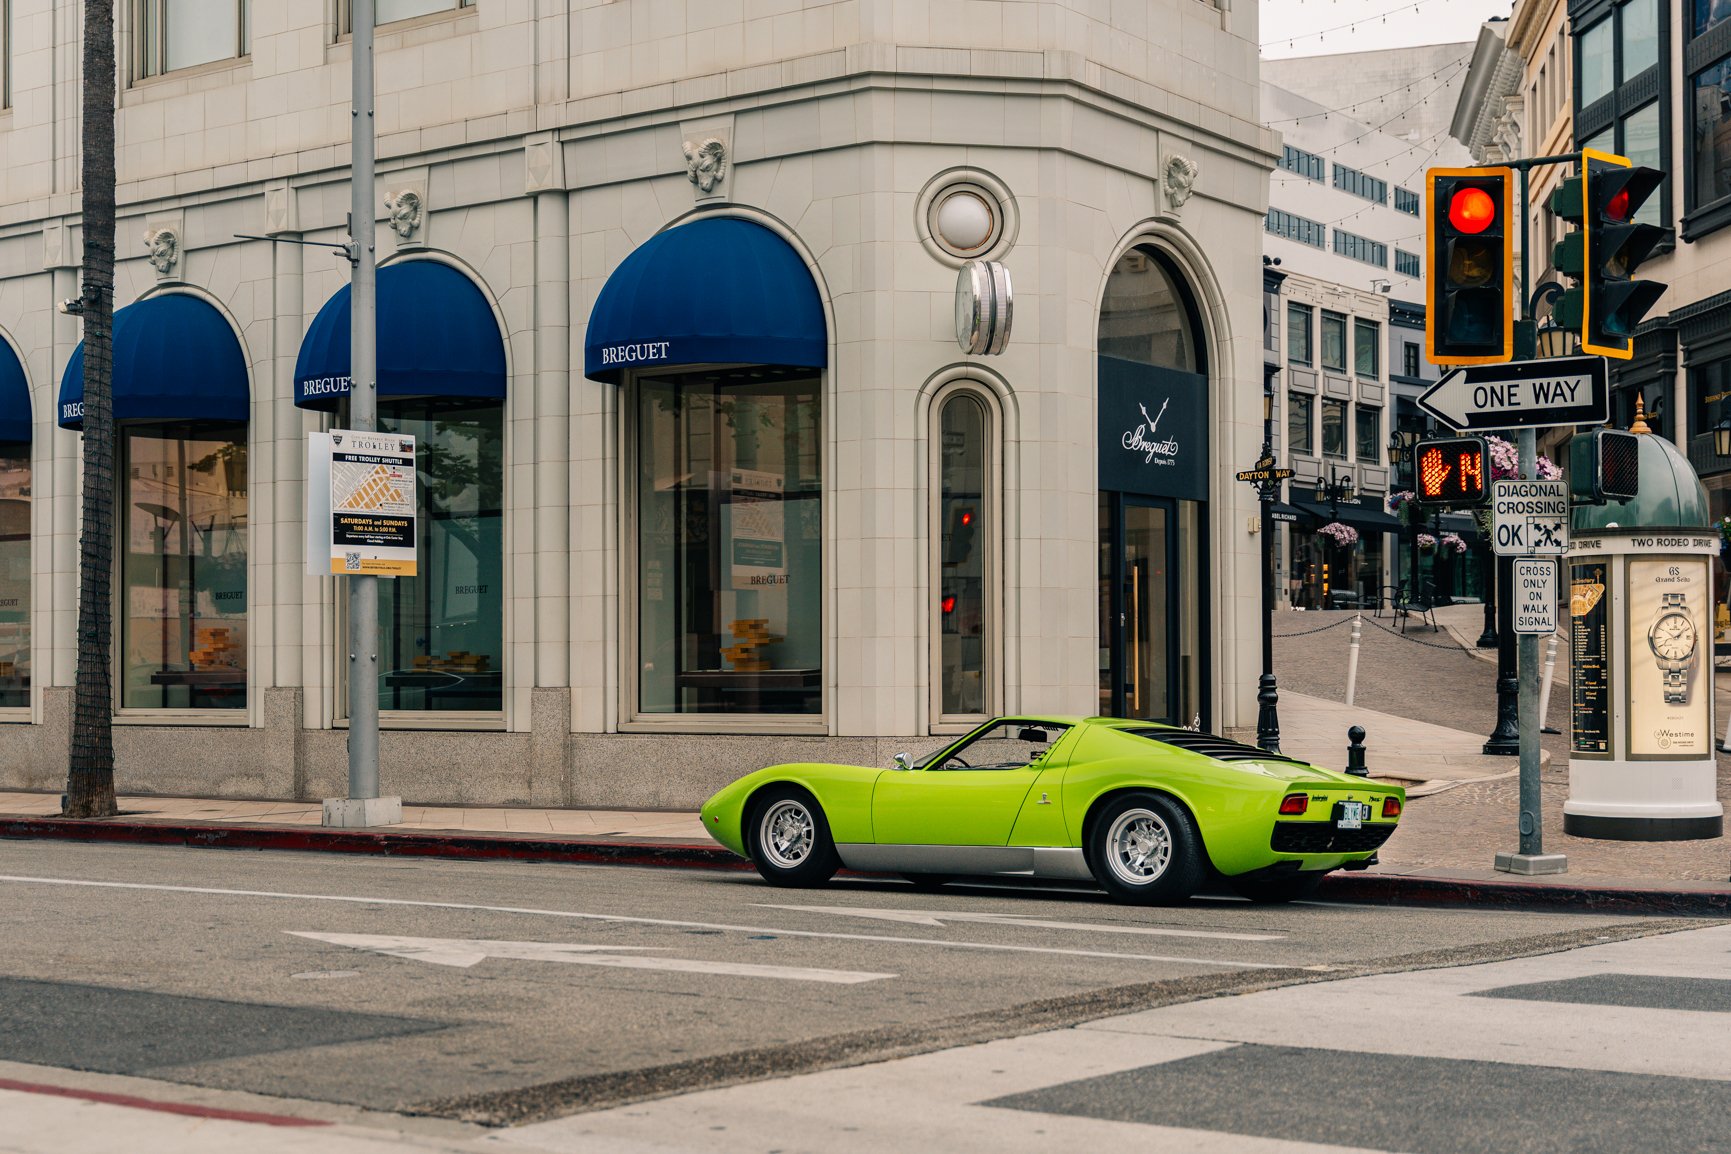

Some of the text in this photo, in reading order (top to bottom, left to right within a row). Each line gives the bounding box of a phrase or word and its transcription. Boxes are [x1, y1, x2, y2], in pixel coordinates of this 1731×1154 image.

[602, 342, 670, 365] BREGUET
[1473, 379, 1581, 409] ONE WAY
[1122, 424, 1179, 464] Breguet
[345, 454, 403, 465] FREE TROLLEY SHUTTLE
[1239, 469, 1290, 480] DAYTON WAY
[1498, 484, 1564, 497] DIAGONAL
[1497, 501, 1566, 514] CROSSING
[340, 517, 373, 525] SATURDAYS
[383, 519, 408, 527] SUNDAYS
[1497, 524, 1523, 547] OK
[1578, 540, 1602, 549] DRIVE
[1631, 538, 1713, 548] TWO RODEO DRIVE
[1519, 566, 1551, 576] CROSS
[750, 574, 790, 585] BREGUET
[1523, 579, 1547, 589] ONLY
[455, 585, 489, 595] BREGUET
[215, 591, 243, 600] BREGUET
[1529, 591, 1542, 601] ON
[1523, 604, 1548, 614] WALK
[1518, 616, 1553, 626] SIGNAL
[1660, 729, 1695, 738] Westime
